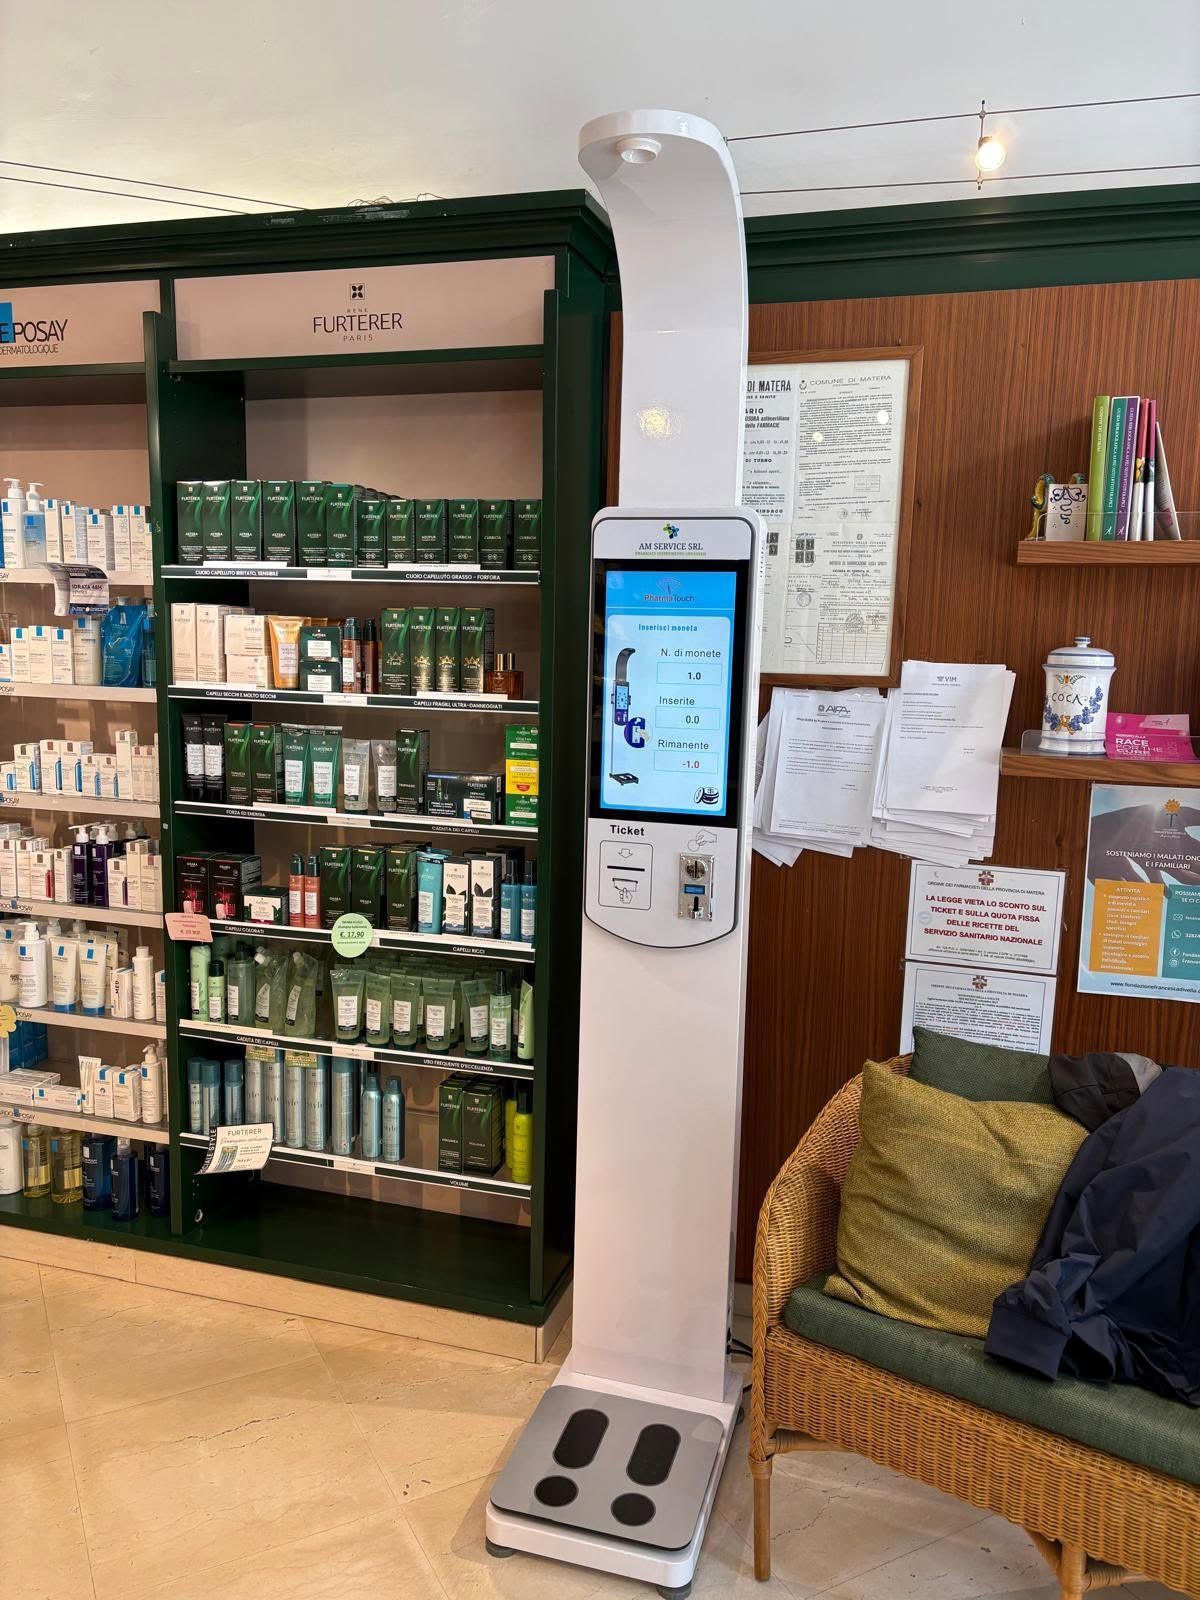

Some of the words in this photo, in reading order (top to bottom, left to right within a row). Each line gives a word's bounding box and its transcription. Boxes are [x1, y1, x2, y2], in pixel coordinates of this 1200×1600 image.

[313, 312, 403, 334] FURTERER
[13, 319, 69, 343] POSAY
[343, 333, 374, 342] PARIS
[747, 380, 756, 392] DI
[758, 380, 792, 392] MATERA
[639, 542, 653, 550] AM
[654, 542, 686, 550] SERVICE
[688, 542, 704, 551] SRL
[661, 649, 671, 657] N.
[675, 649, 683, 657] di
[685, 650, 721, 658] monete
[688, 672, 702, 680] 1.0
[660, 696, 695, 706] Inserite
[1051, 692, 1083, 706] COCA
[686, 715, 700, 724] 0.0
[657, 739, 709, 750] Rimanente
[1115, 738, 1149, 746] RACE
[682, 760, 700, 769] -1.0
[609, 824, 645, 836] Ticket
[1105, 850, 1152, 859] SOSTENIAMO
[1155, 862, 1191, 870] FAMILIARI
[937, 895, 962, 904] LEGGE
[964, 898, 985, 906] VIETA
[998, 901, 1030, 910] SCONTO
[1031, 904, 1047, 912] SUL
[931, 906, 956, 915] TICKET
[965, 910, 989, 918] SULLA
[991, 912, 1016, 920] QUOTA
[1018, 914, 1040, 923] FISSA
[946, 919, 971, 927] DELLE
[972, 921, 1003, 931] RICETTE
[1004, 924, 1020, 932] DEL
[924, 928, 958, 937] SERVIZIO
[959, 931, 999, 942] SANITARIO
[1000, 935, 1043, 946] NAZIONALE
